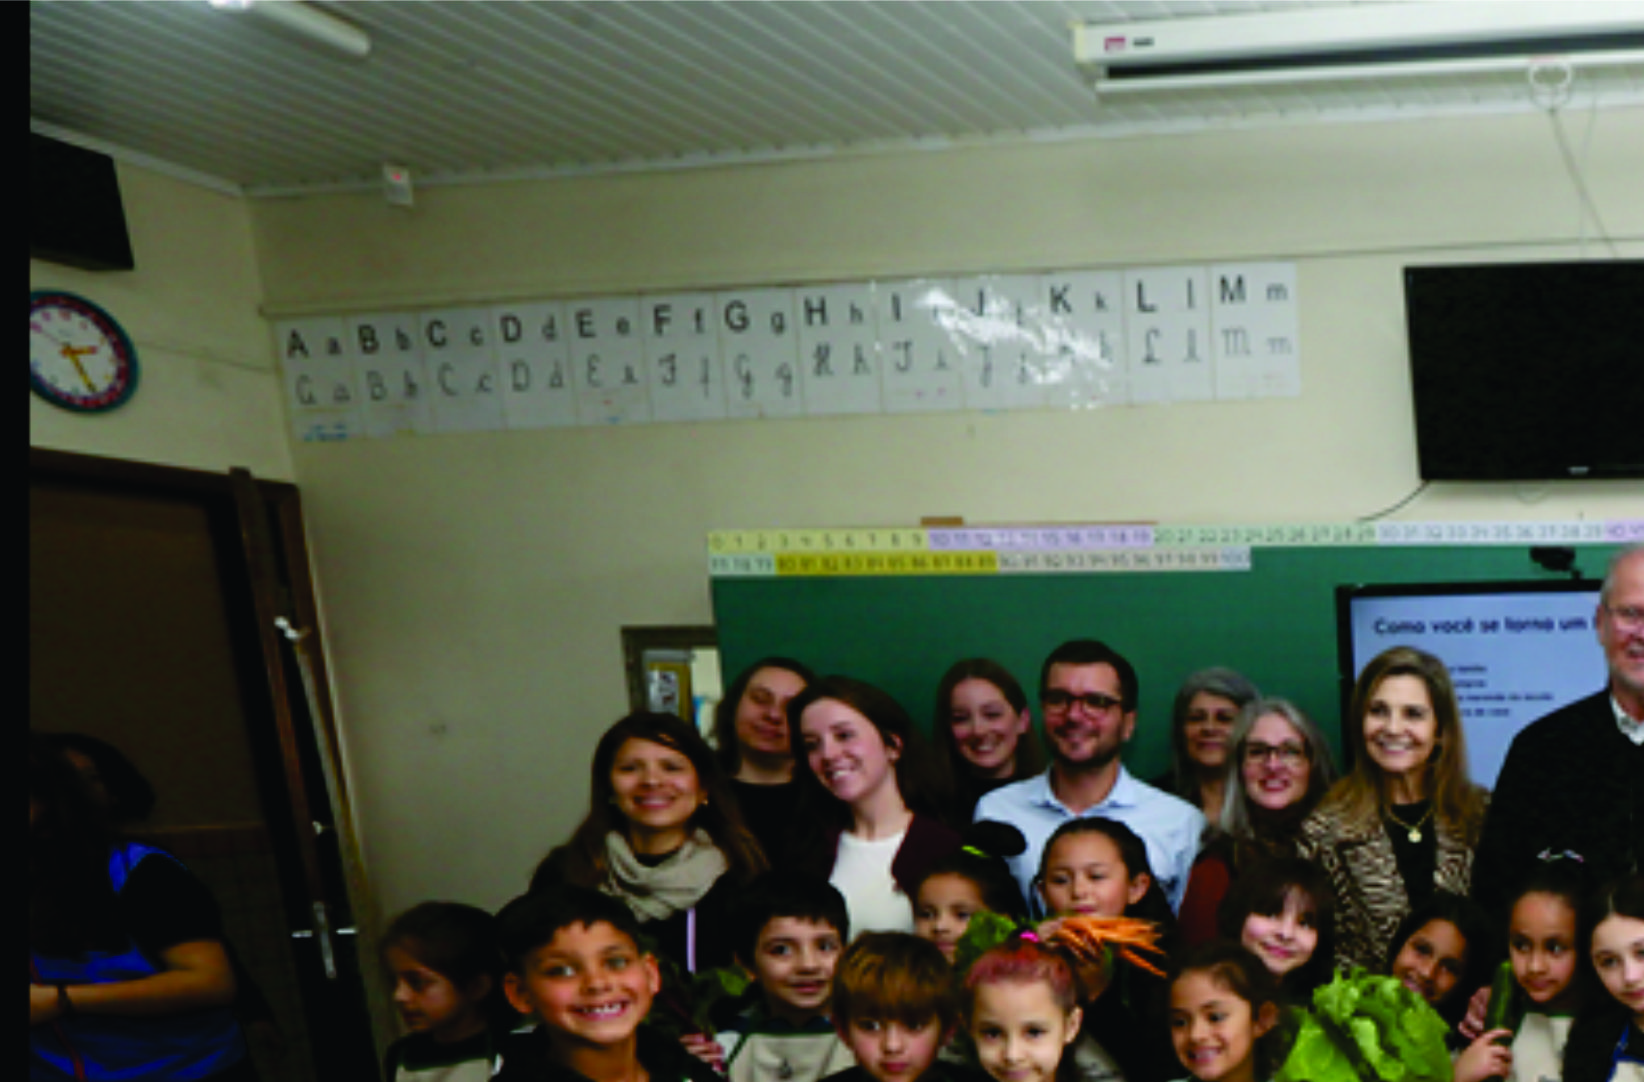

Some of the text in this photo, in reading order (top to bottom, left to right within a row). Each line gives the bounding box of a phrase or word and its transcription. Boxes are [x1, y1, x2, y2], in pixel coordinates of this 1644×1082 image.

[287, 329, 308, 357] A
[359, 325, 379, 354] B
[396, 323, 411, 350] b
[427, 320, 447, 347] C
[469, 326, 484, 346] c
[502, 316, 522, 342] D
[542, 316, 556, 341] d
[577, 310, 596, 338] E
[616, 316, 630, 335] e
[654, 305, 671, 335] F
[725, 302, 748, 332] G
[806, 297, 826, 326] H
[851, 303, 862, 323] h
[973, 290, 984, 317] J
[1051, 285, 1072, 312] K
[1138, 282, 1156, 312] L
[1221, 276, 1245, 303] M
[1266, 283, 1287, 300] m
[1374, 617, 1425, 635] Como
[1432, 616, 1474, 634] você
[1480, 619, 1498, 634] se
[1559, 617, 1588, 631] um
